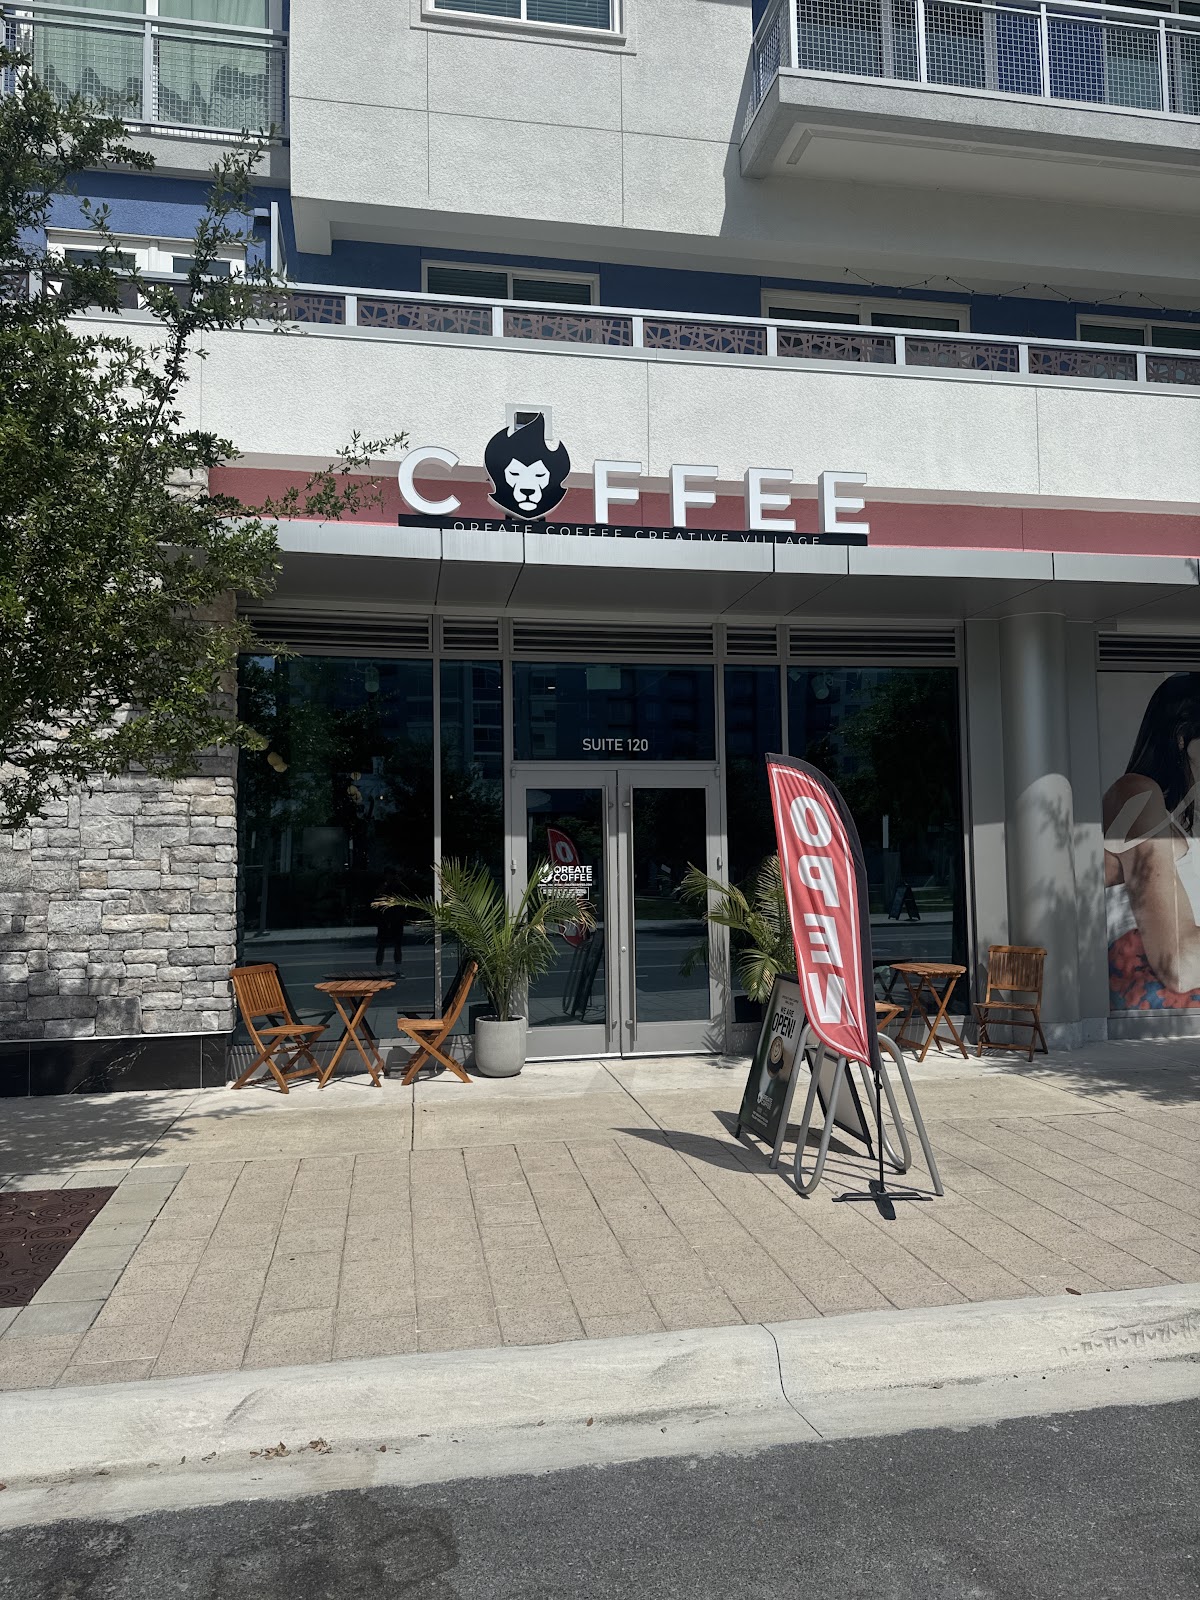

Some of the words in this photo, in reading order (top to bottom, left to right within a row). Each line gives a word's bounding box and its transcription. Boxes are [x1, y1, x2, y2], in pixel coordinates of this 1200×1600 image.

[398, 446, 870, 534] CFFEE
[582, 738, 624, 751] SUITE
[627, 738, 649, 751] 120
[553, 873, 593, 882] COFFEE
[771, 1012, 797, 1039] OPEN!
